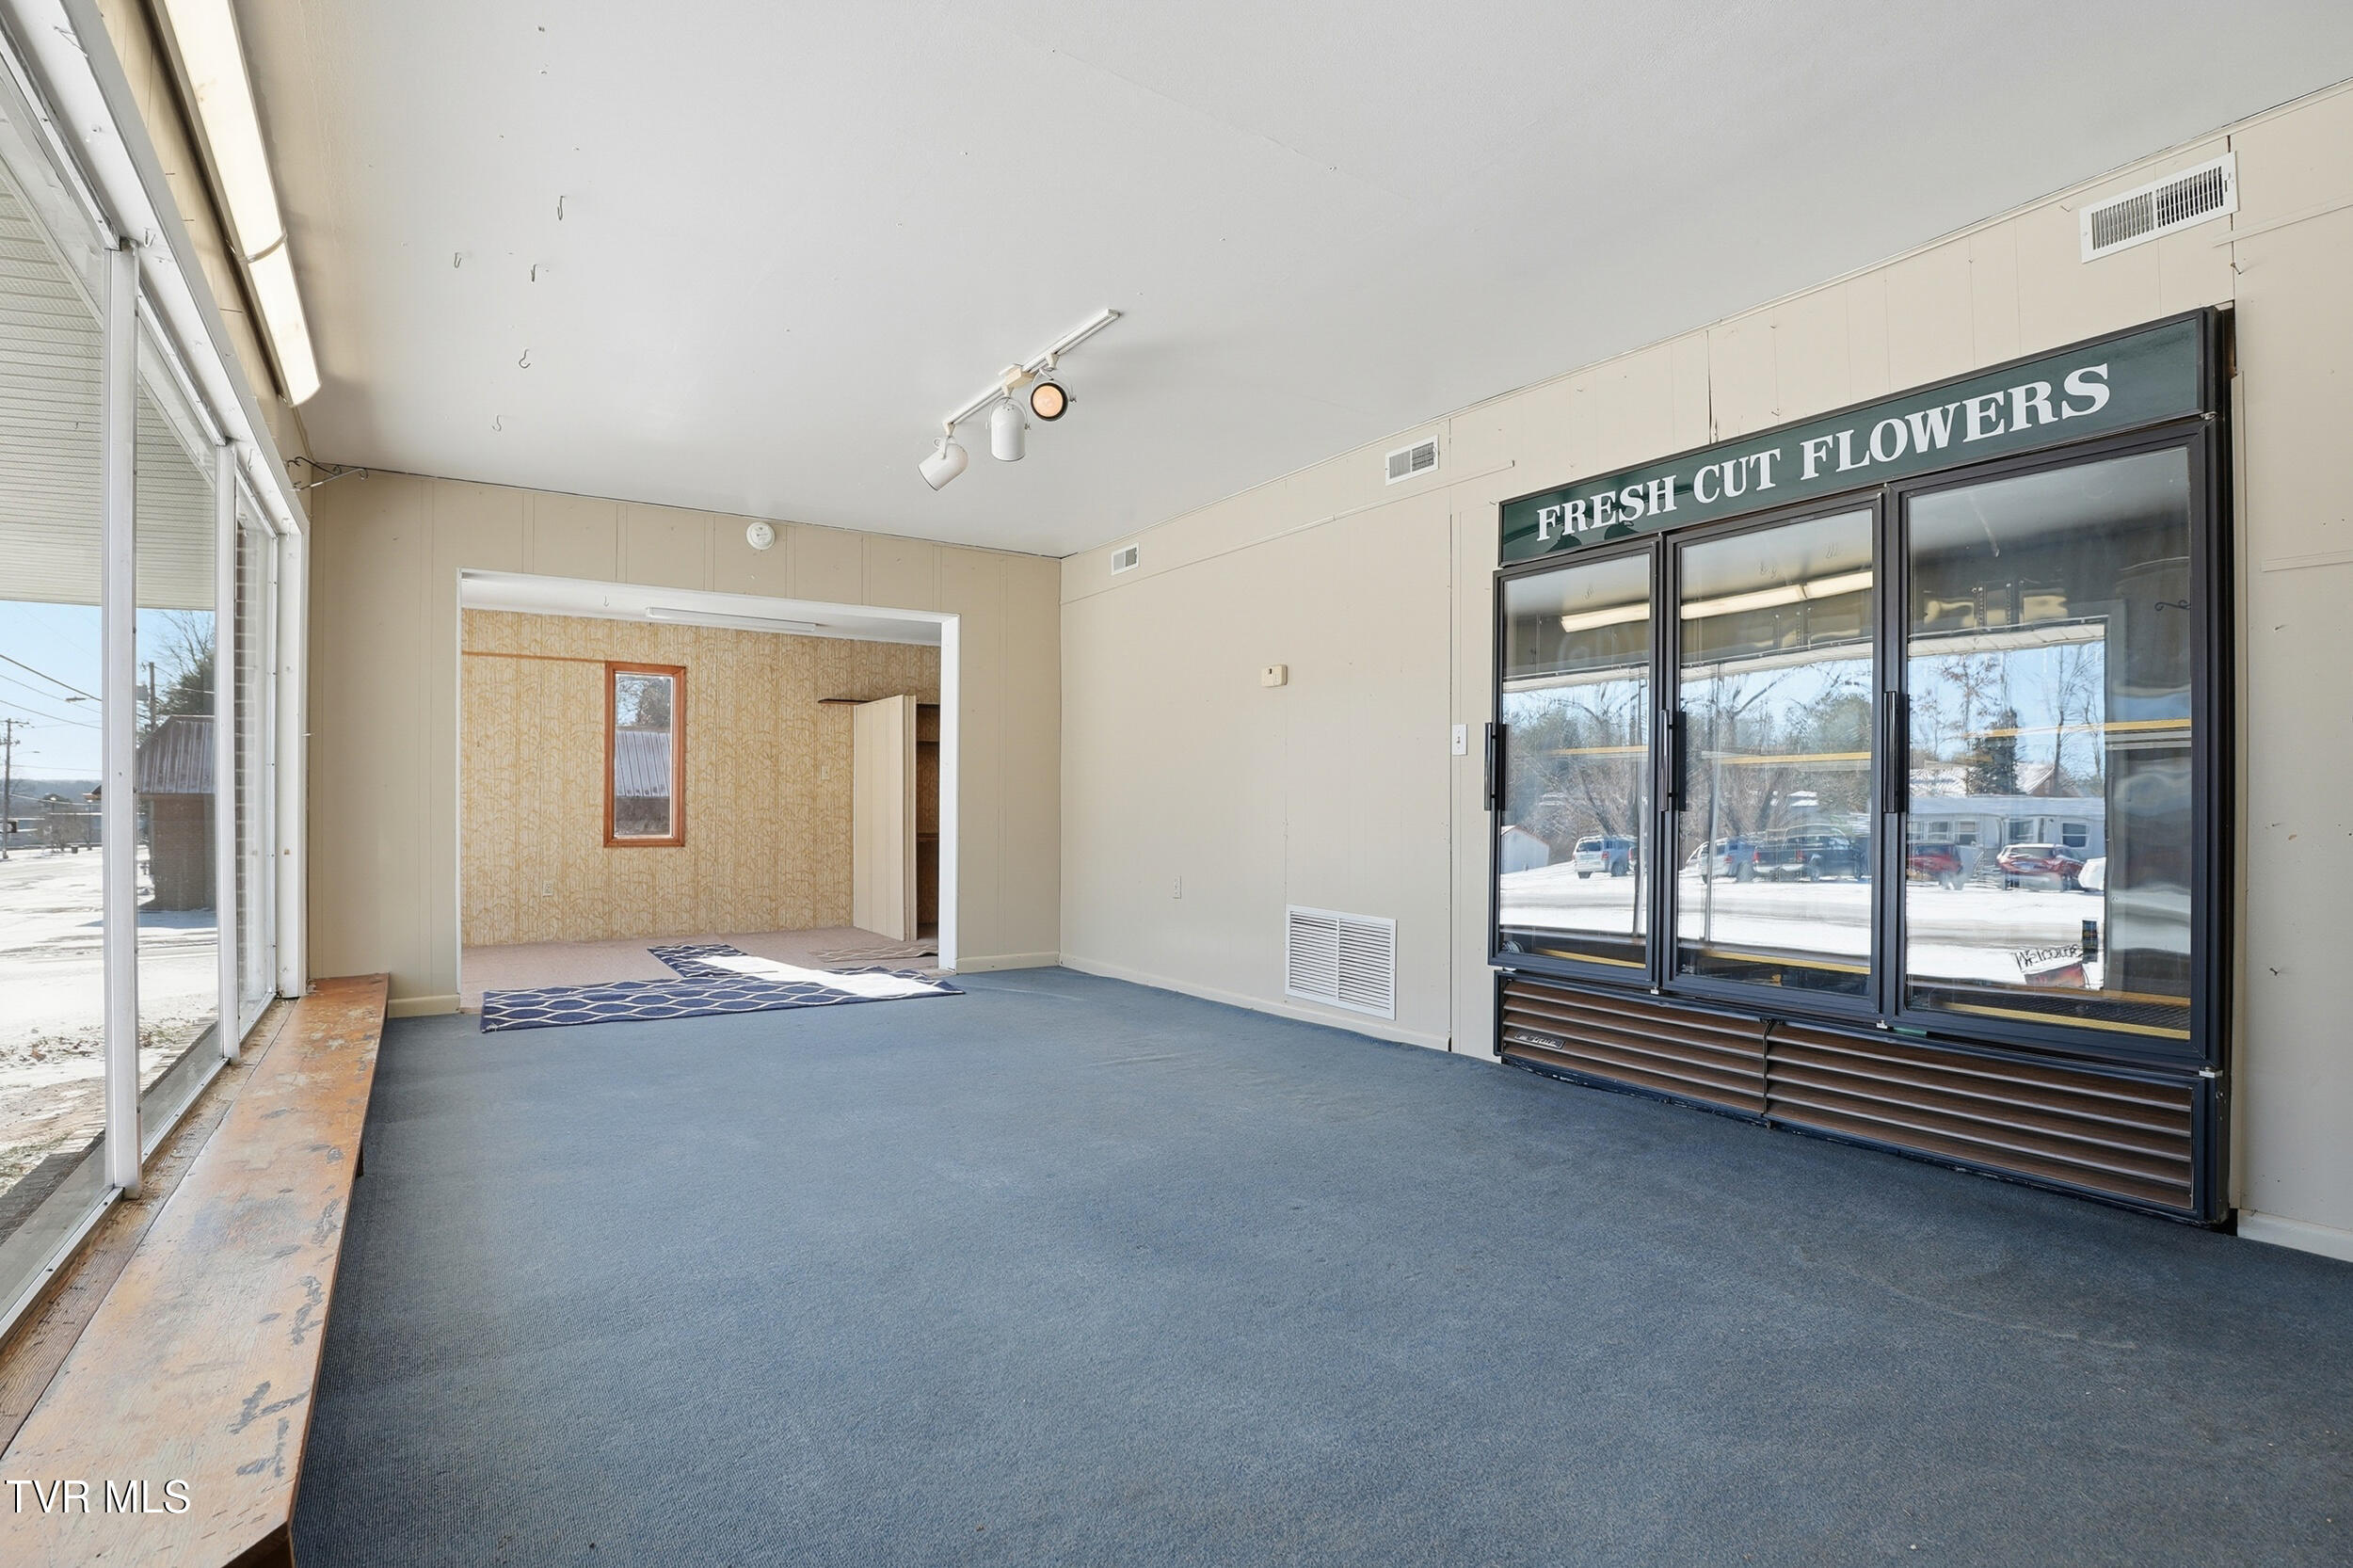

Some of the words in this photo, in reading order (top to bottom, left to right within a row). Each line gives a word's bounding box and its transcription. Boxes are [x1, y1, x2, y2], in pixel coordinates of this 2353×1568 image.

[1536, 474, 1678, 542] FRESH
[1693, 447, 1781, 504] CUT
[1799, 362, 2110, 481] FLOWERS
